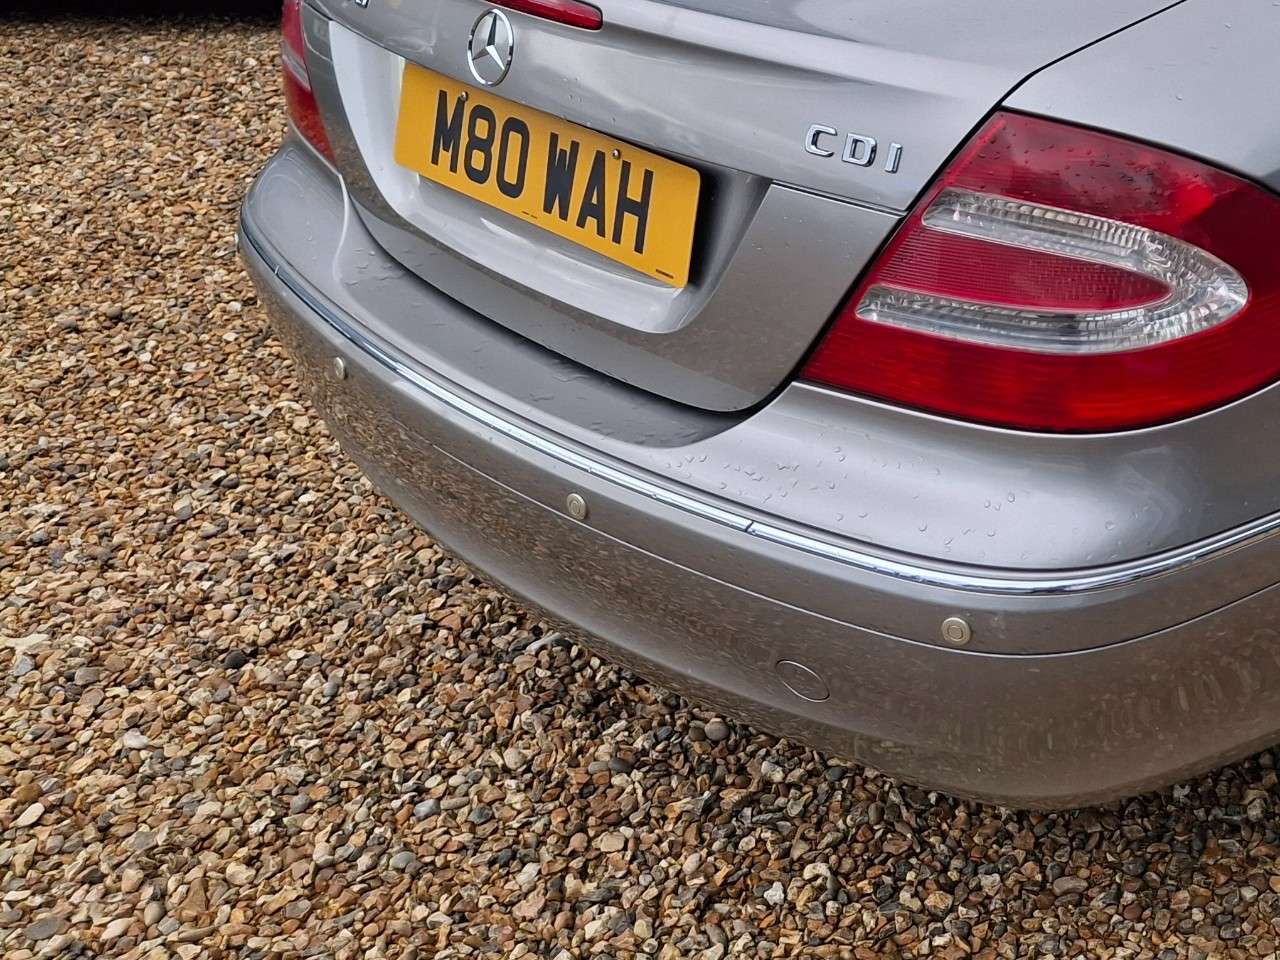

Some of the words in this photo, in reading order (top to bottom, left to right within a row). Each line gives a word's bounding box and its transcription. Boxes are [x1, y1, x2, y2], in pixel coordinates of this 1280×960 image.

[430, 89, 530, 200] M80
[542, 131, 655, 256] WAH
[805, 123, 903, 174] CDI
